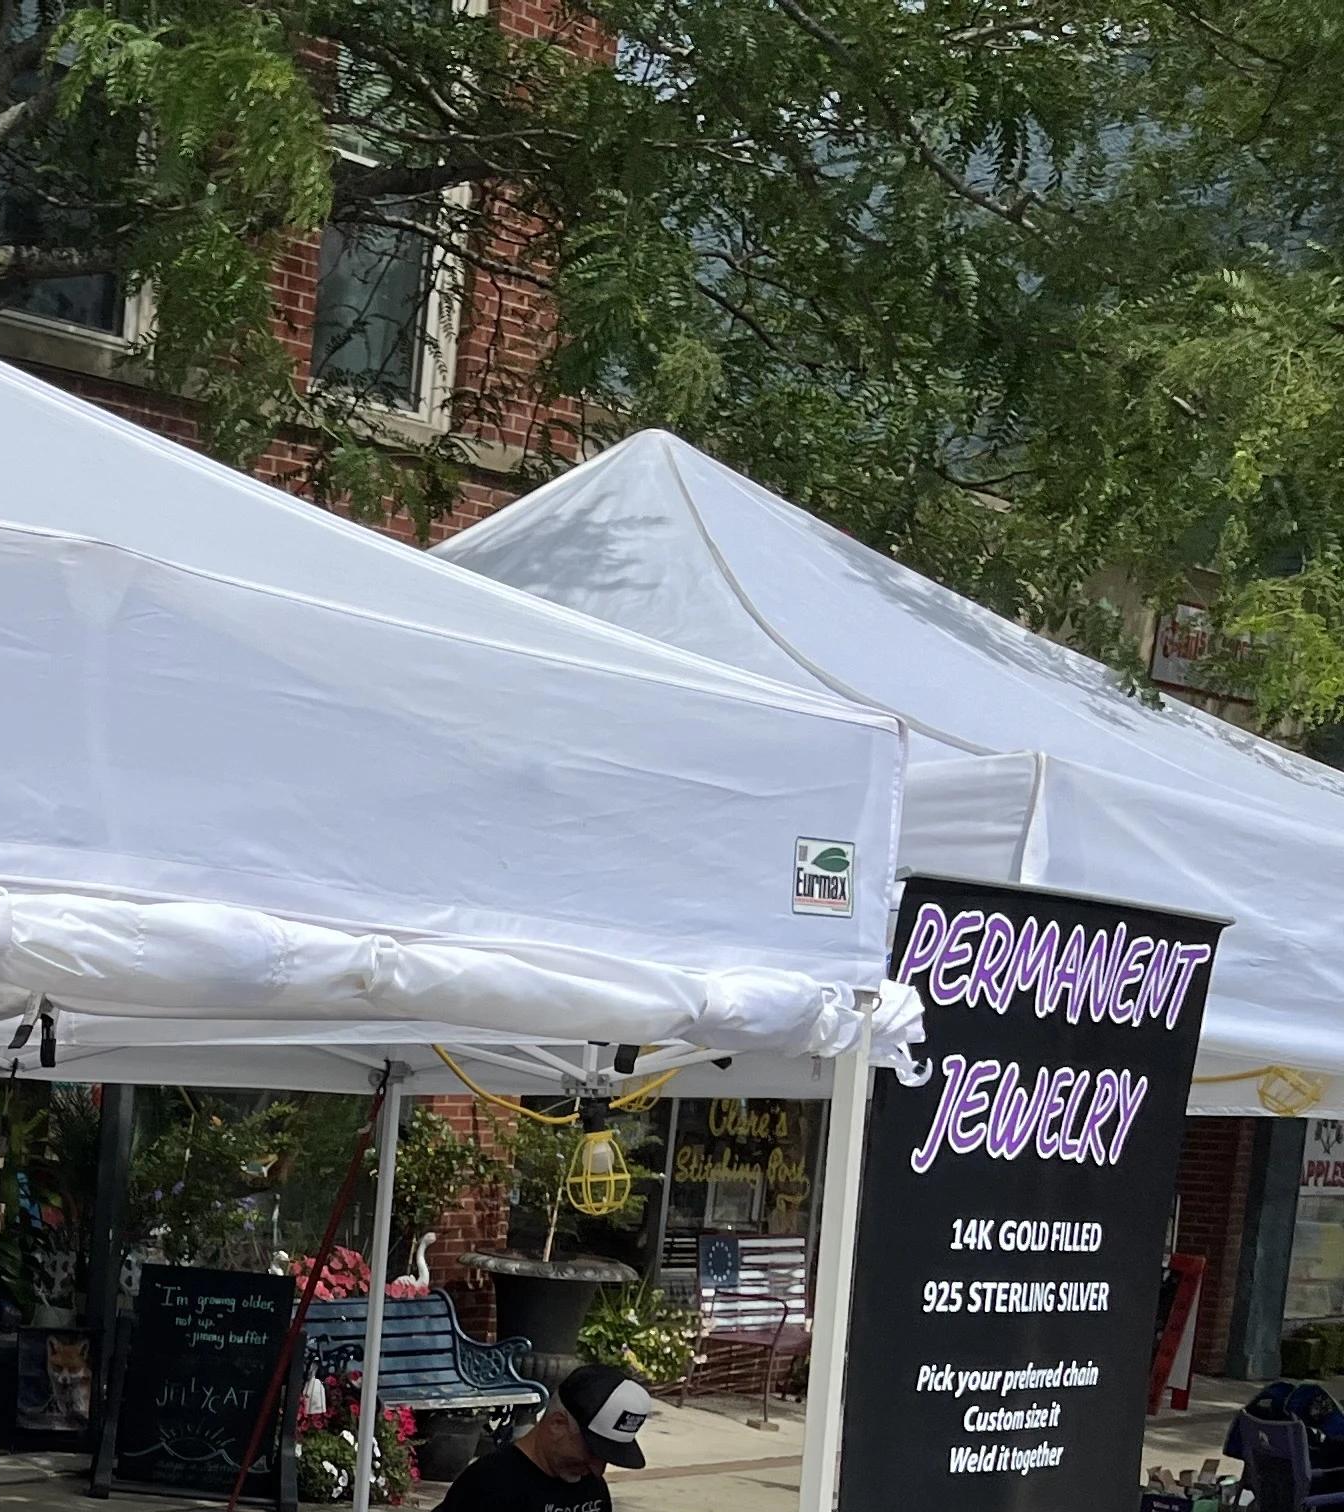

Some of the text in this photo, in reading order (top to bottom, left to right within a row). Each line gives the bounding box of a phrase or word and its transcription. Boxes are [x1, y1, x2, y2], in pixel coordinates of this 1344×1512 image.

[796, 867, 847, 901] Eurmax
[896, 903, 1211, 1030] PERMANENT
[911, 1054, 1148, 1174] JEWELRY
[674, 1145, 808, 1189] Stitching Post
[950, 1219, 1102, 1252] 14K GOLD FILLED
[197, 1295, 236, 1314] growing
[923, 1281, 1109, 1313] 925 STERLING SILVER
[175, 1316, 193, 1327] not
[228, 1330, 268, 1346] buffet
[916, 1360, 1099, 1398] Pick your preferred chain
[963, 1401, 1061, 1432] Custom size it
[949, 1441, 1064, 1476] Weld it together
